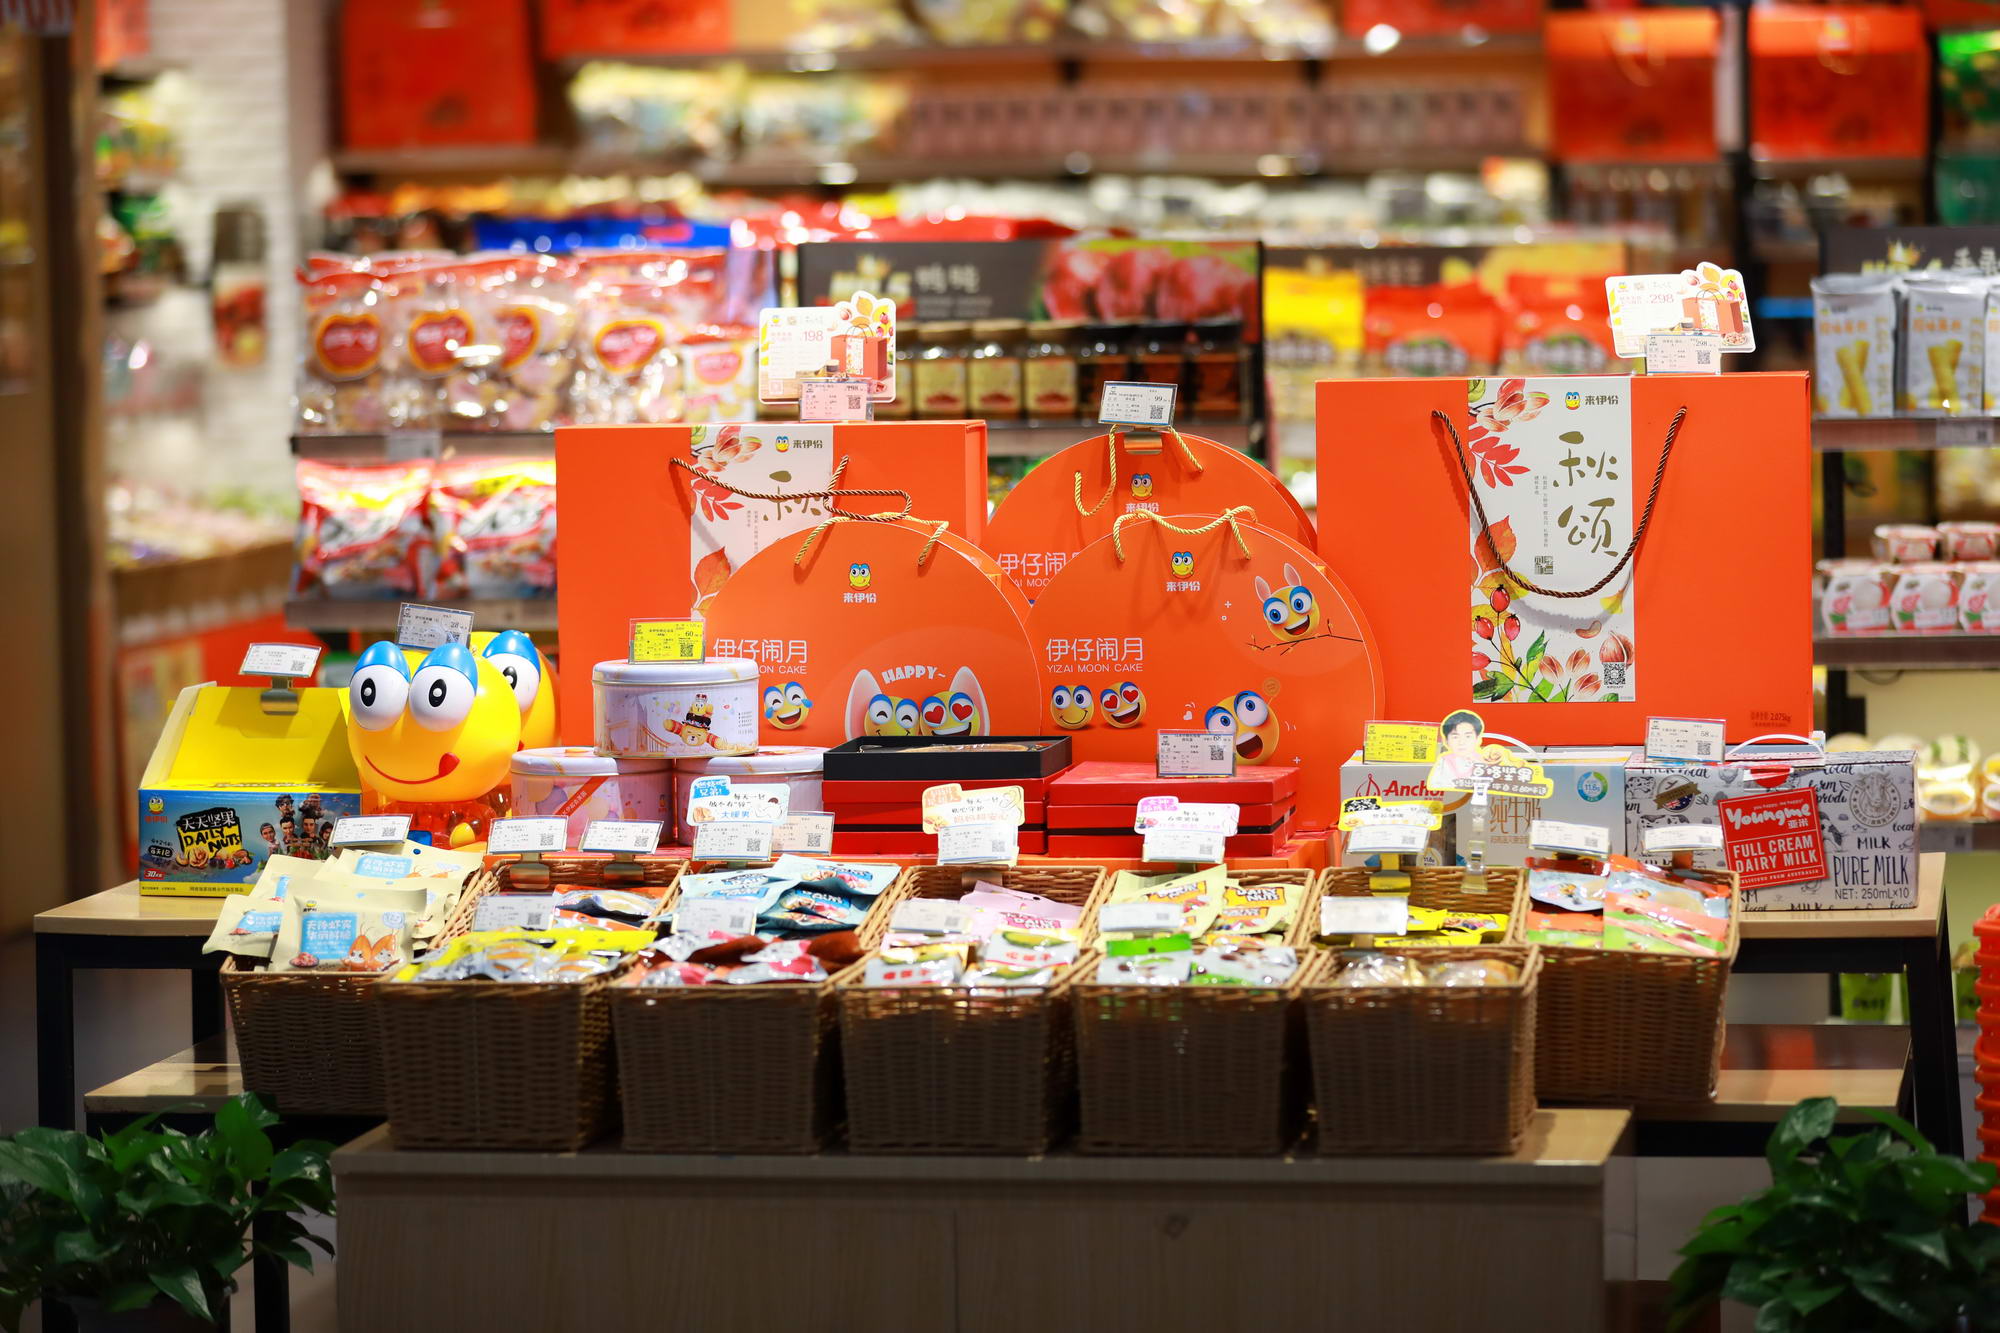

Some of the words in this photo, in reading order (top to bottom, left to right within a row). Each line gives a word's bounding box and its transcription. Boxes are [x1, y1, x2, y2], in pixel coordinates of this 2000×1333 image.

[1650, 294, 1674, 304] 298
[803, 330, 824, 342] 198
[1585, 395, 1619, 405] 来伊份
[793, 439, 823, 449] 来伊份
[997, 552, 1081, 576] 伊仔闹
[1166, 581, 1201, 592] 来伊份
[843, 593, 877, 603] 来伊份
[713, 638, 807, 664] 伊仔闹月
[1046, 638, 1143, 663] 伊仔闹月
[779, 665, 807, 675] CAKE
[1047, 664, 1074, 673] YIZAI
[1078, 664, 1110, 673] MOON
[1114, 663, 1143, 673] CAKE
[183, 811, 235, 831] 天天坚果
[1725, 804, 1812, 830] Youngme
[184, 828, 225, 846] DAILY
[209, 834, 240, 852] NUTS
[1857, 837, 1891, 850] MILK
[1733, 842, 1765, 859] FULL
[1768, 835, 1813, 854] CREAM
[1735, 855, 1777, 874] DAIRY
[1783, 850, 1818, 867] MILK
[1833, 855, 1870, 888] PURE
[1874, 855, 1909, 886] MILK
[1835, 888, 1858, 900] NET:
